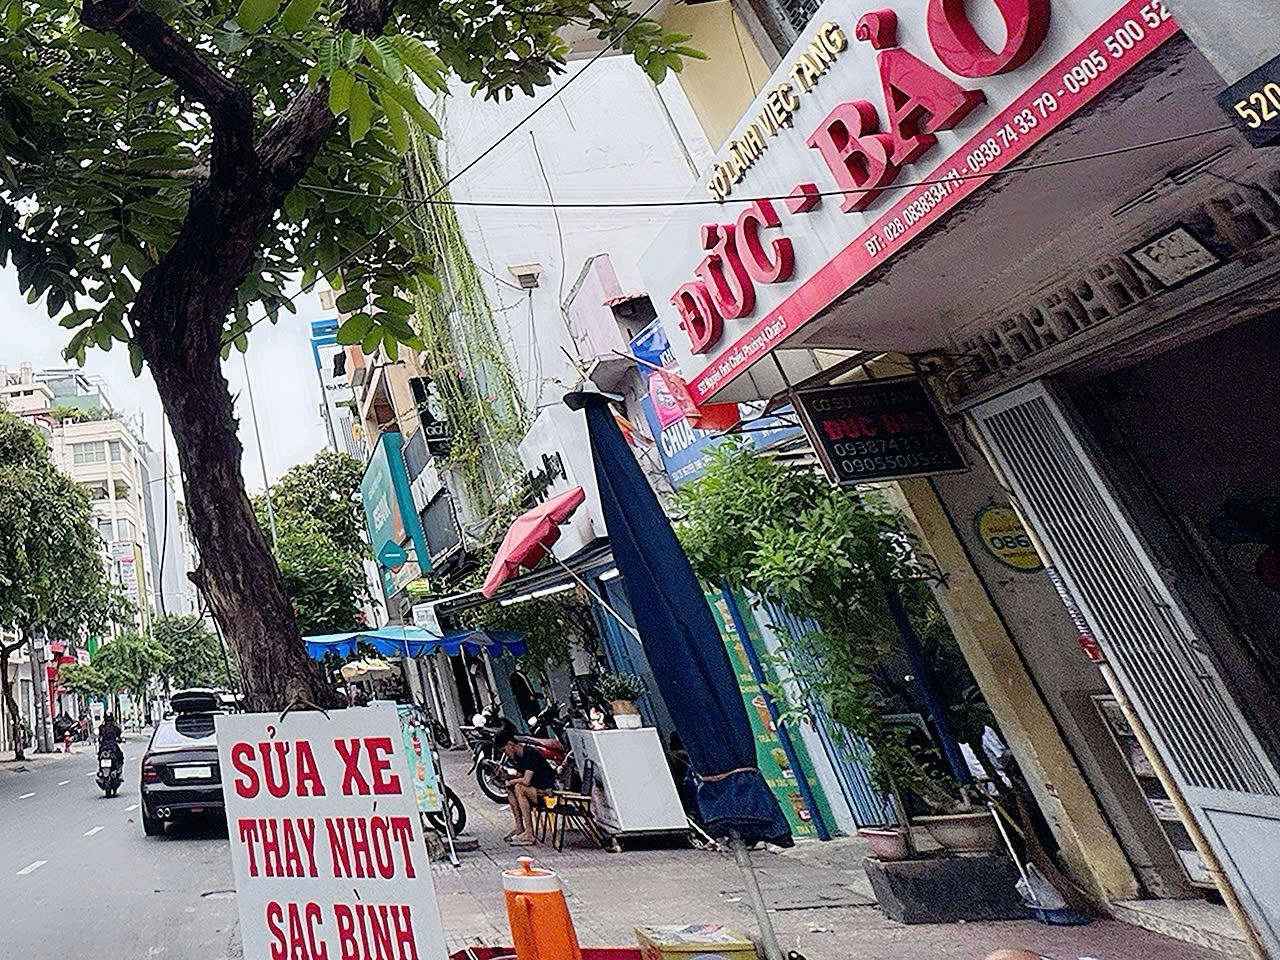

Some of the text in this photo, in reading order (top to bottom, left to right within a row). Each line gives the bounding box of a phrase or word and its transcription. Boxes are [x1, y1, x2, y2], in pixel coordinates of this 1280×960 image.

[789, 20, 848, 94] TANG
[966, 138, 1001, 173] 0938
[997, 124, 1019, 148] 74
[1013, 108, 1038, 134] 33
[1033, 92, 1058, 119] 79
[1063, 49, 1108, 94] 0905
[1103, 19, 1145, 59] 500
[1233, 82, 1280, 129] 520
[670, 197, 796, 355] ĐỨC
[231, 725, 403, 800] SỬA XE
[238, 801, 417, 880] THAY NHỚT
[333, 888, 420, 960] BÌNH
